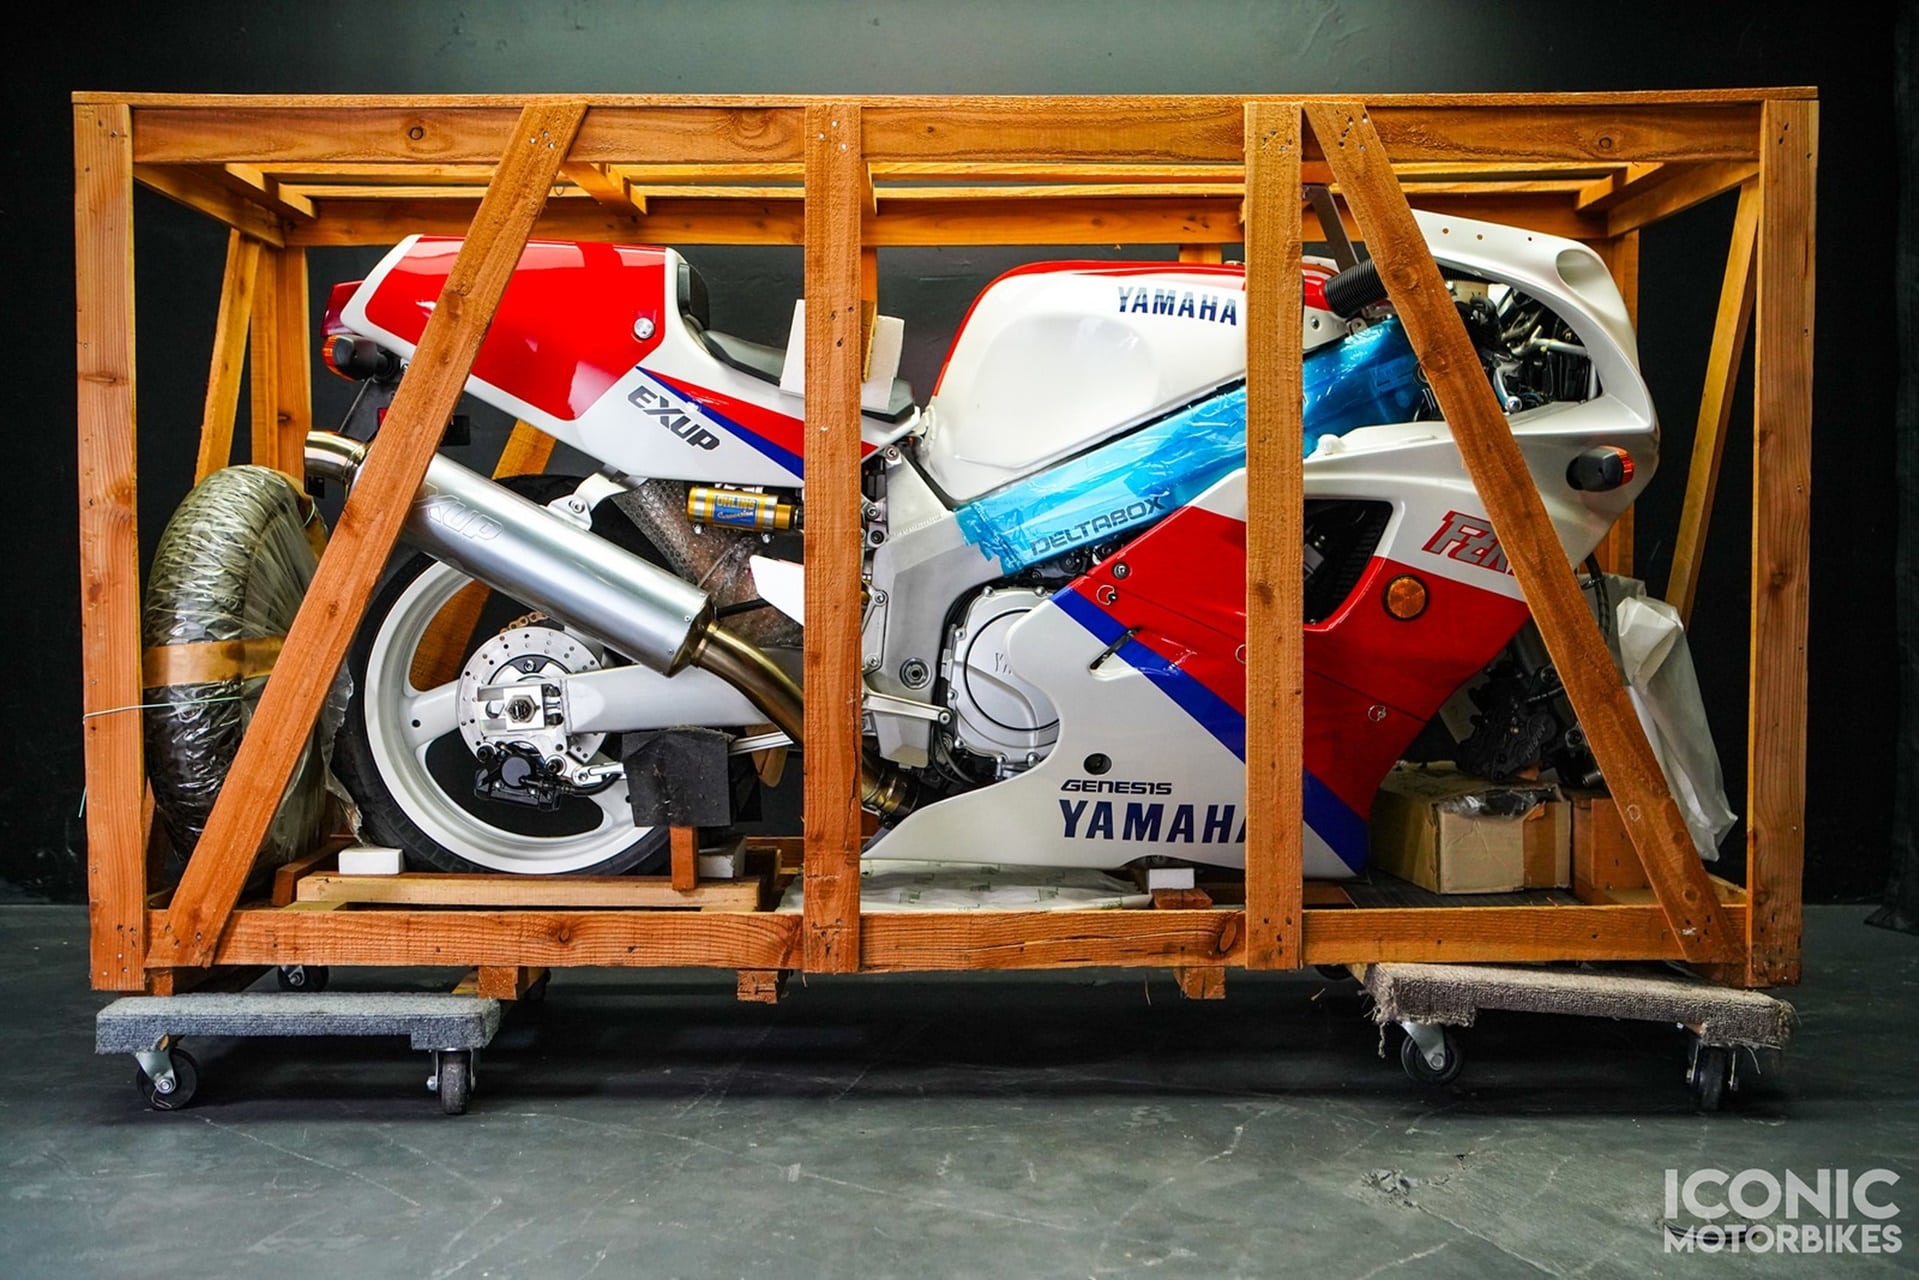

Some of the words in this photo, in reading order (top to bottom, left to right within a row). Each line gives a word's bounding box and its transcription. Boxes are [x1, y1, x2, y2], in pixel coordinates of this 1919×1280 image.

[1118, 286, 1237, 326] YAMAHA
[627, 385, 720, 450] EXUP
[411, 481, 503, 540] XUP
[1031, 496, 1166, 556] DELTABOX
[1060, 779, 1172, 795] GENESIS
[1059, 799, 1247, 844] YAMAH
